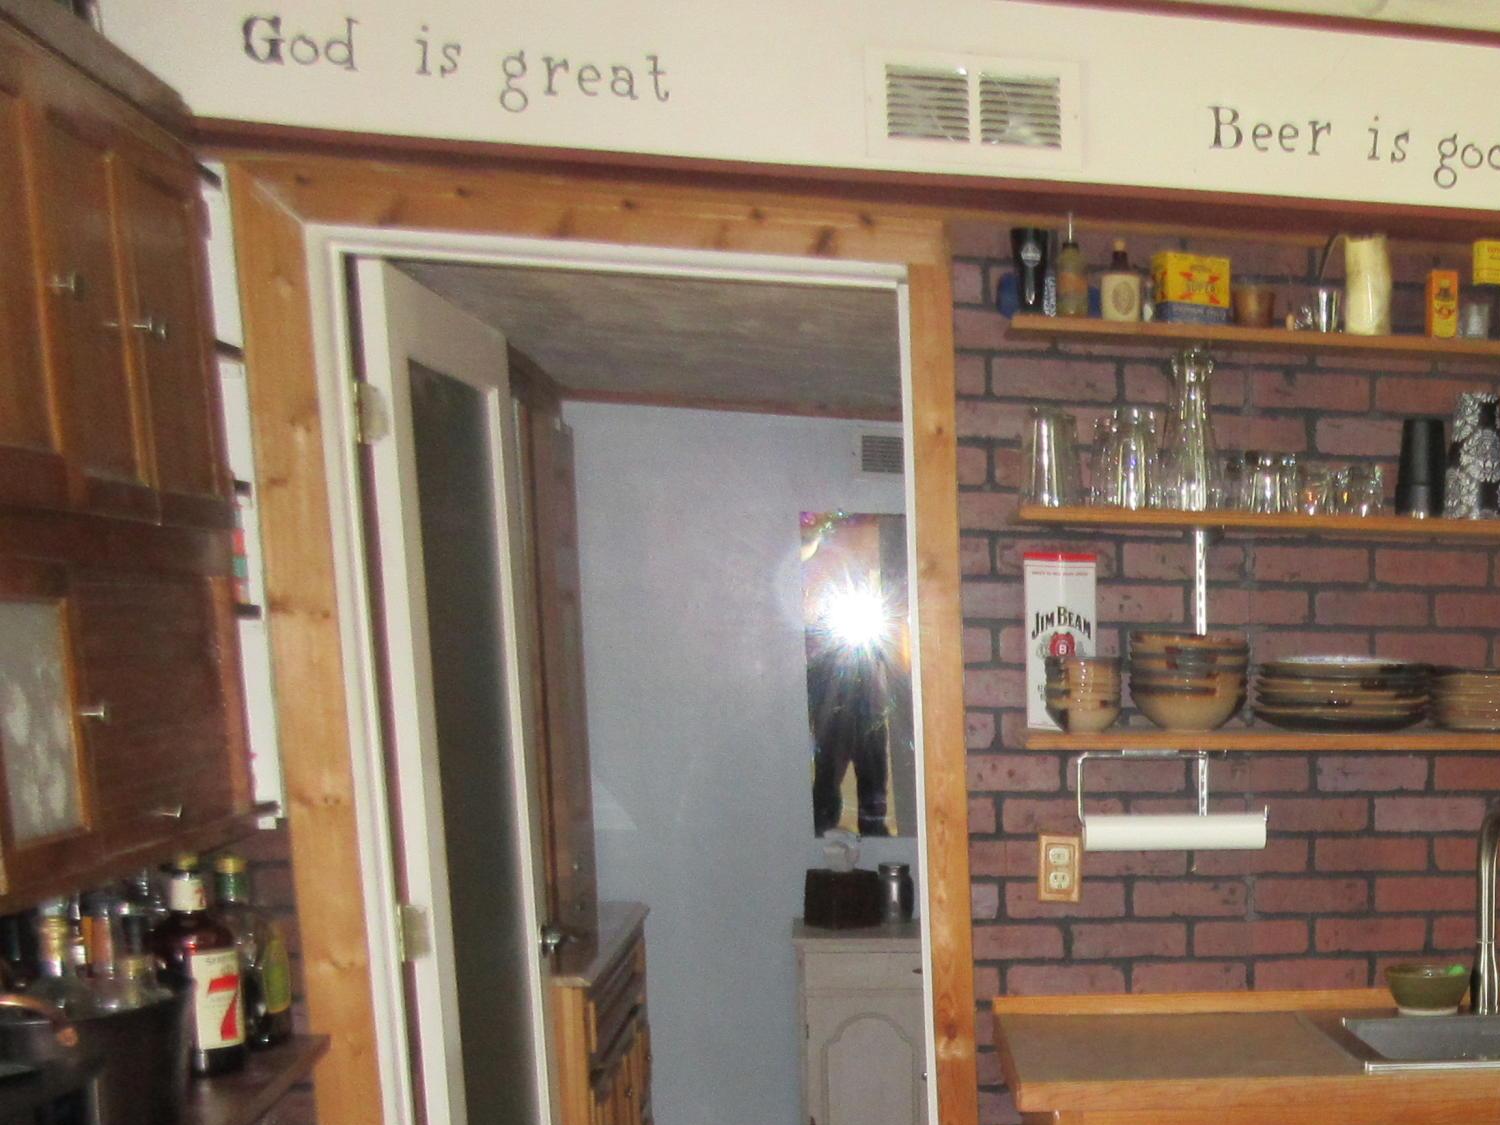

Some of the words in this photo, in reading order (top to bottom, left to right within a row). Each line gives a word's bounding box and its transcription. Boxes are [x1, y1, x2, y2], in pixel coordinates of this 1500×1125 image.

[242, 15, 359, 71] God
[415, 25, 462, 77] is
[498, 50, 671, 113] great
[1207, 106, 1332, 156] Beer
[1366, 115, 1410, 164] is
[1031, 612, 1056, 641] JIM
[1057, 606, 1091, 641] BEAM
[207, 974, 240, 1041] 7
